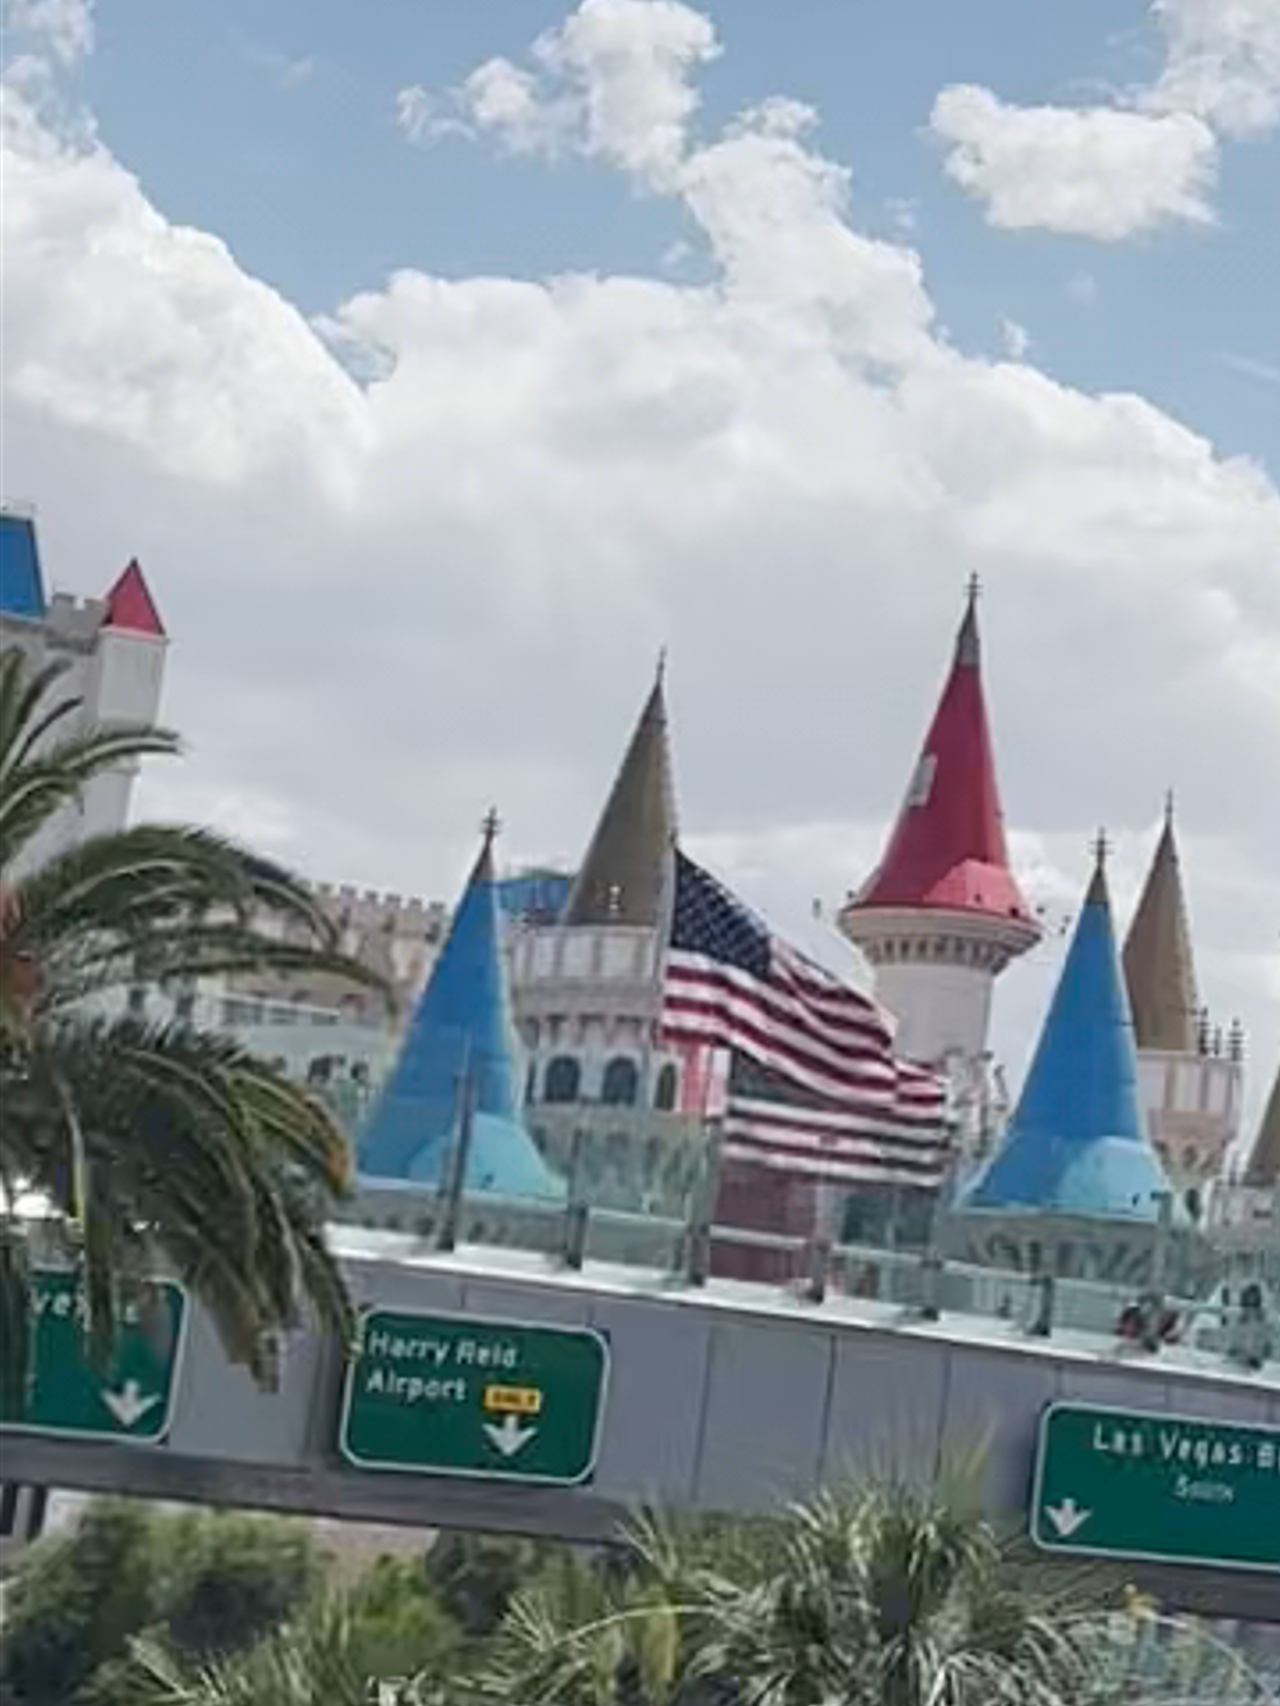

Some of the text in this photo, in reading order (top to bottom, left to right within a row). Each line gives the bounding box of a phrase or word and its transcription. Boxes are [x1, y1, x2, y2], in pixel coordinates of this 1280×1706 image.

[368, 1330, 518, 1369] Harry Reid
[366, 1368, 468, 1402] Airport
[1093, 1422, 1142, 1455] Las
[1159, 1428, 1243, 1470] Vegas
